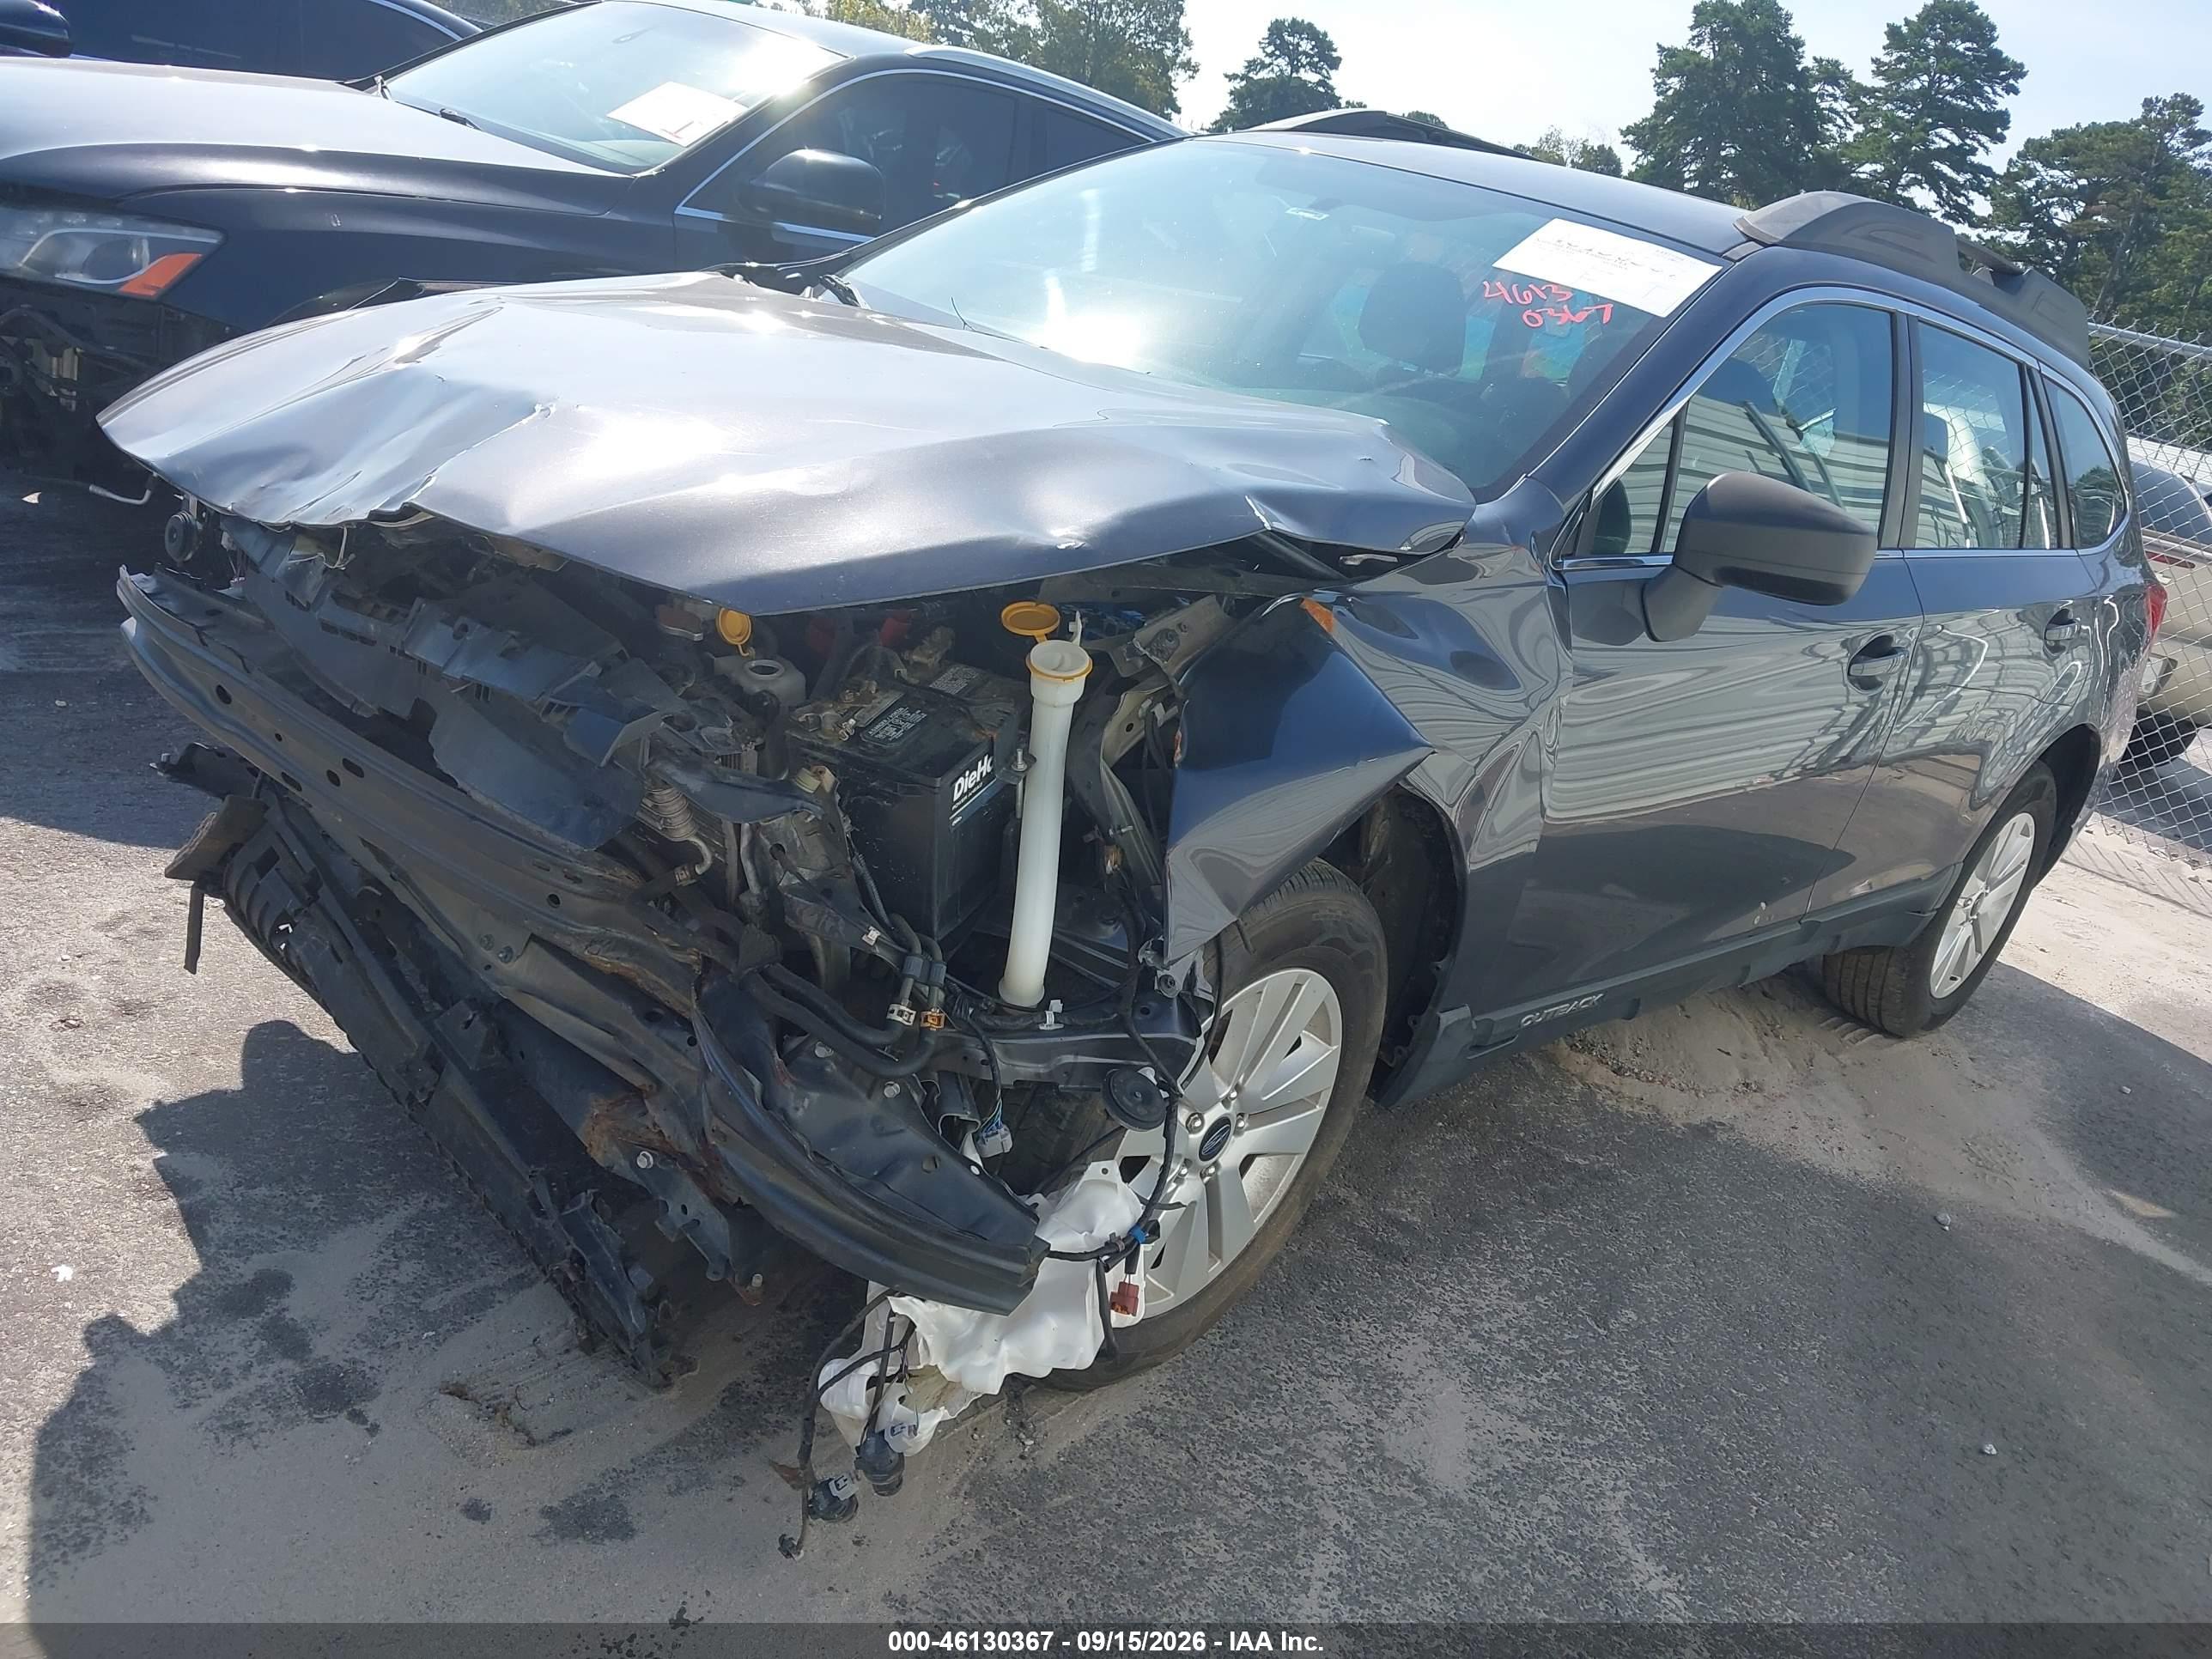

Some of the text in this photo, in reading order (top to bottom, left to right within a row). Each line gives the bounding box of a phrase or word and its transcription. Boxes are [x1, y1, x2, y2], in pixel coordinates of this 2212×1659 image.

[1483, 281, 1573, 304] 4613
[1522, 303, 1613, 328] 0367
[1521, 994, 1605, 1027] OUTBACK
